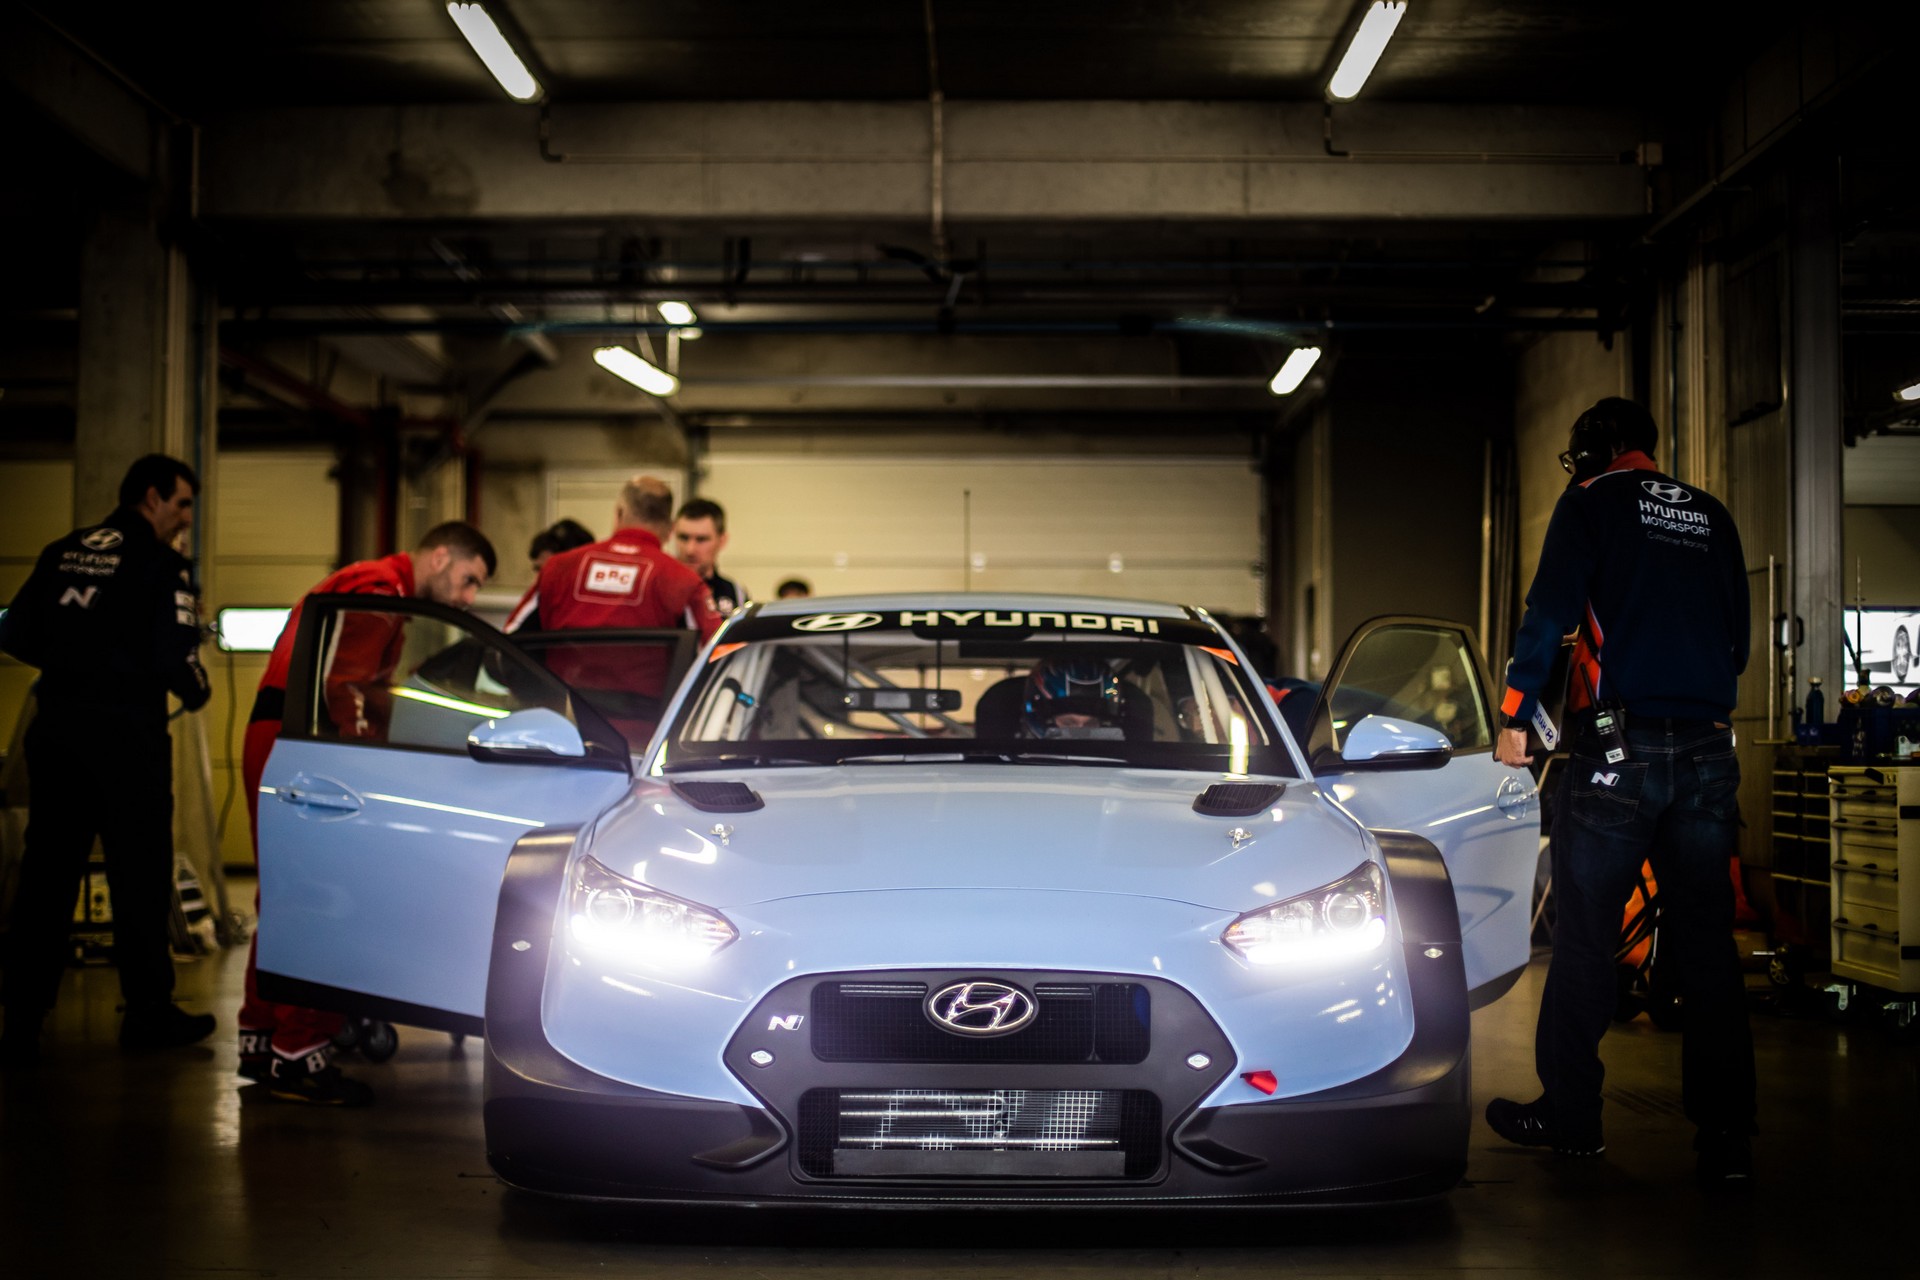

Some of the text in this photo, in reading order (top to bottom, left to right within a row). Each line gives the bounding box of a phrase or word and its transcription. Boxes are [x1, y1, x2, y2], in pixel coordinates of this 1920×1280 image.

[1638, 499, 1709, 525] HYUNDAI
[1641, 514, 1711, 537] MOTORSPORT
[900, 611, 1160, 634] HYUNDAI
